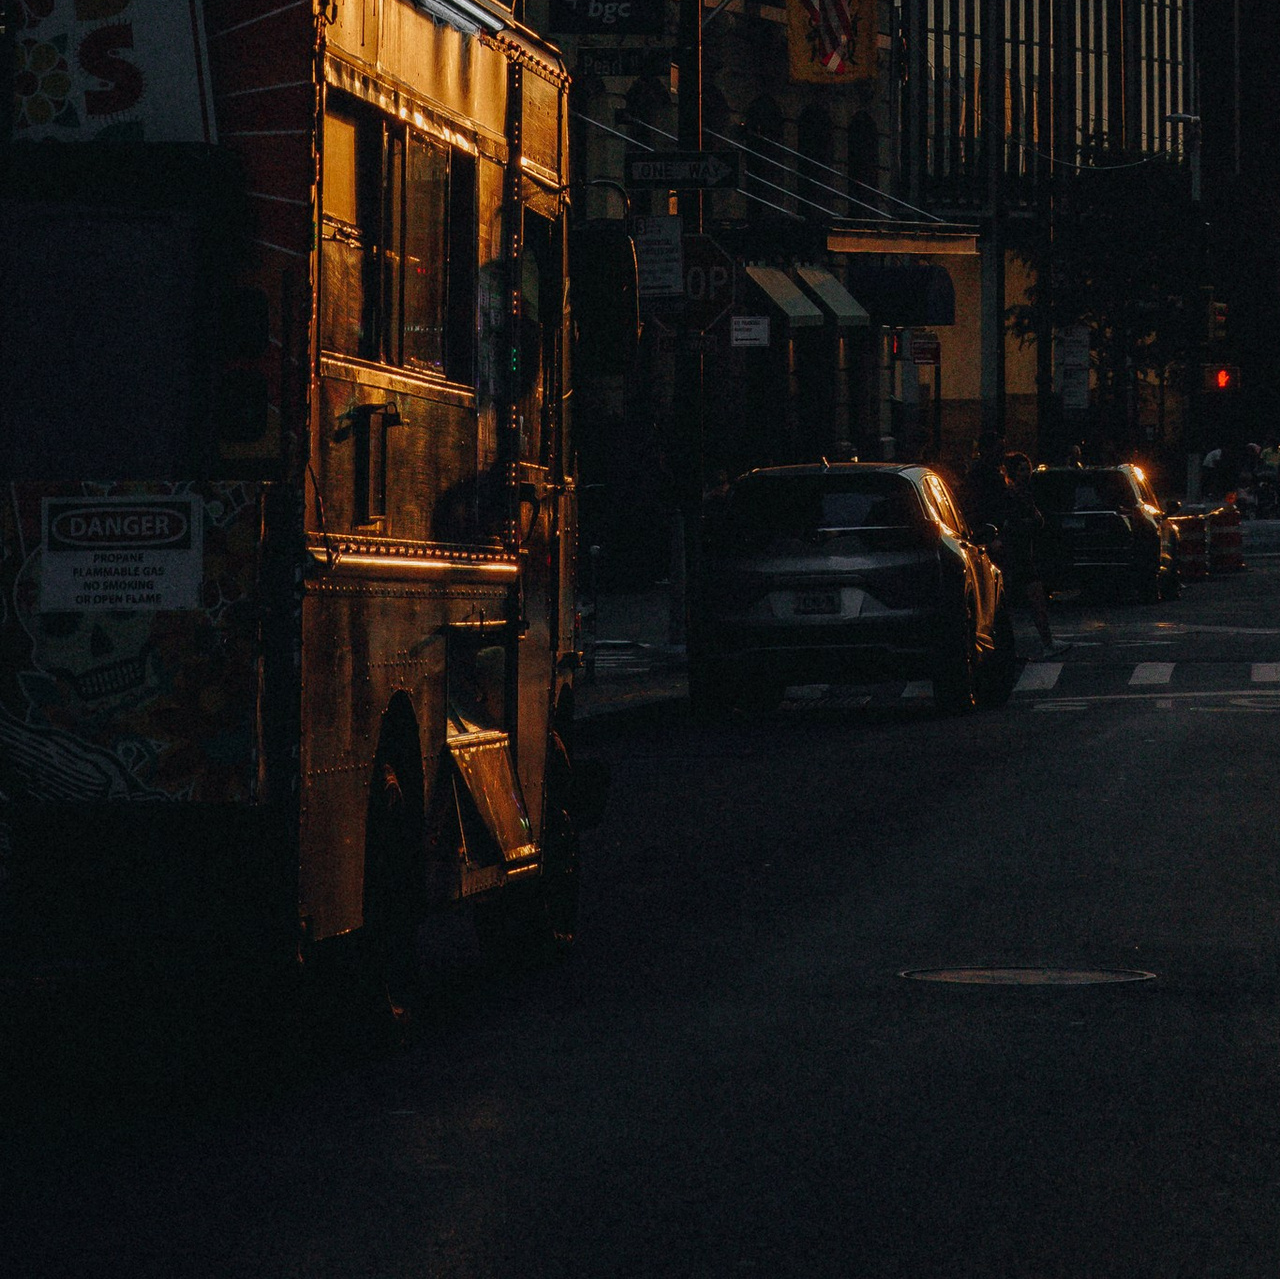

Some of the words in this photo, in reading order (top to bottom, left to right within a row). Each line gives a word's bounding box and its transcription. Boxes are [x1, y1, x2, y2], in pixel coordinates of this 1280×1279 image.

[584, 55, 624, 76] Pearl
[640, 163, 674, 178] ONE
[688, 162, 722, 178] WAY
[687, 266, 729, 301] OP
[69, 514, 170, 537] DANGER
[93, 553, 144, 563] PROPANE
[73, 566, 139, 577] FLAMMABLE
[143, 566, 165, 576] GAS
[83, 580, 100, 591] NO
[102, 580, 154, 591] SMOKING
[75, 594, 90, 605] OR
[93, 593, 122, 605] OPEN
[125, 593, 162, 605] FLAME
